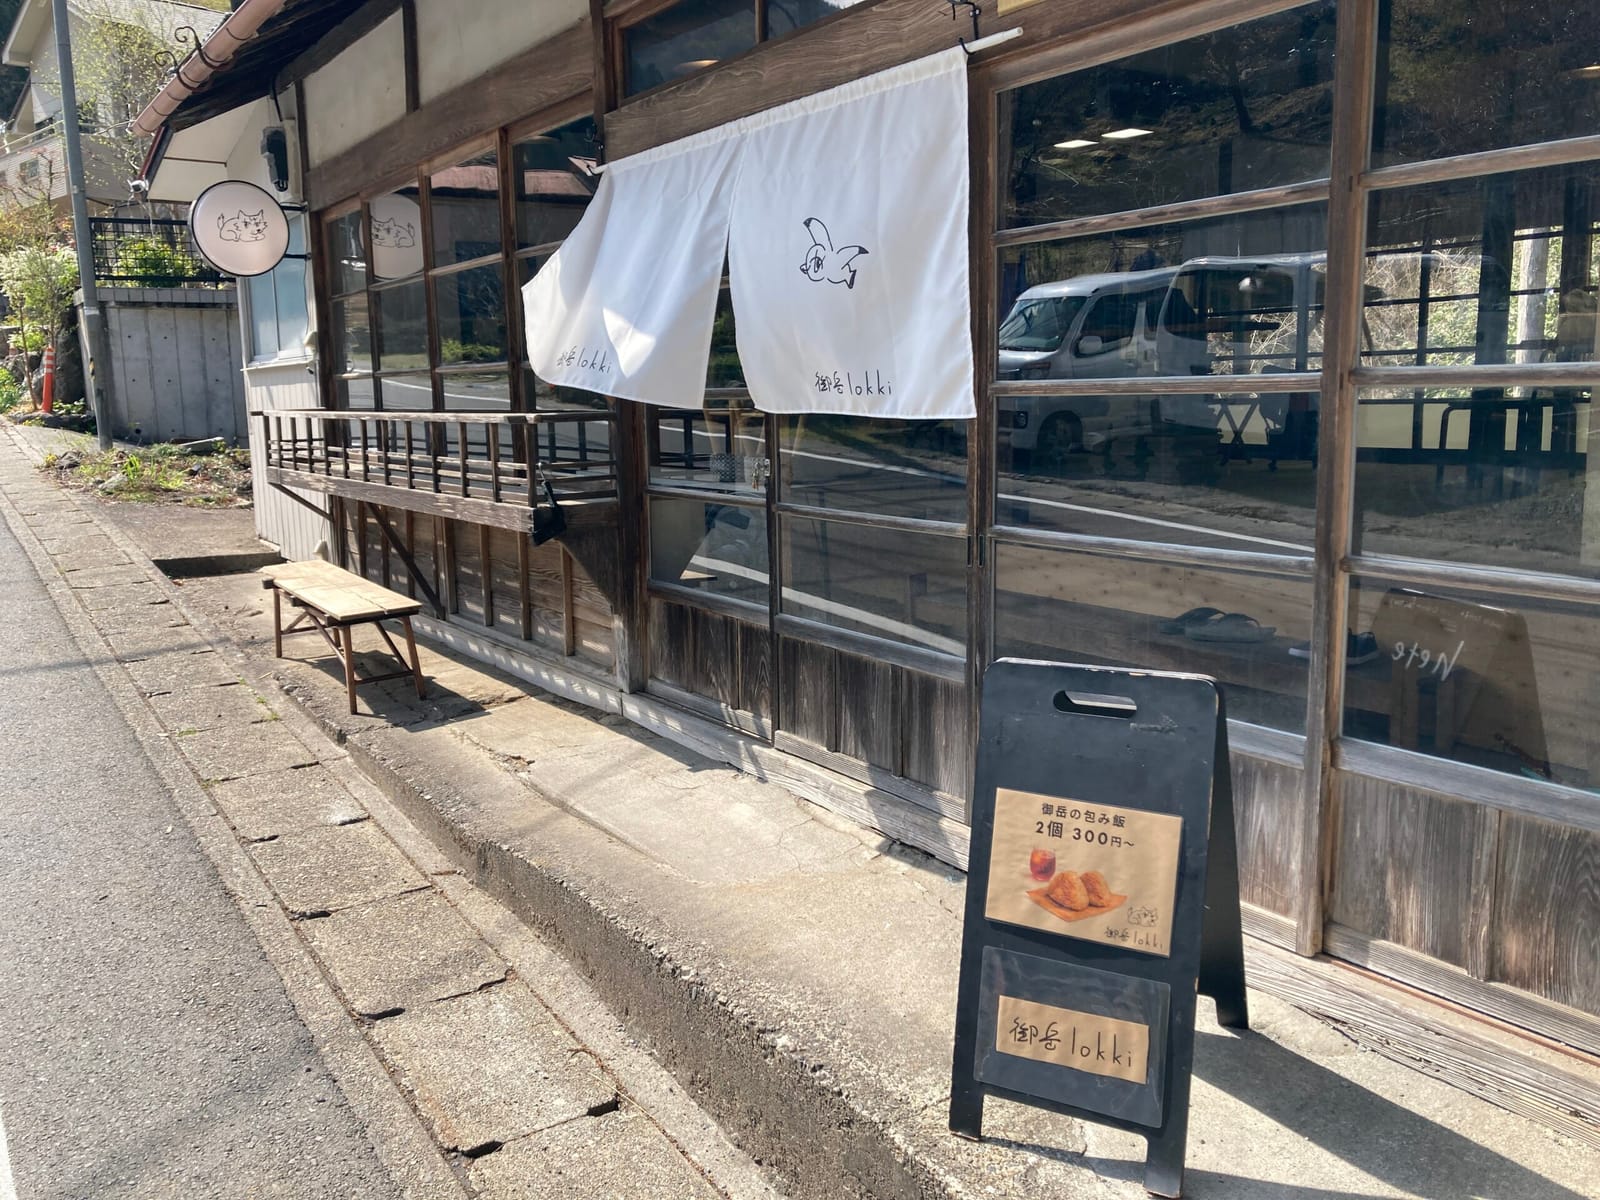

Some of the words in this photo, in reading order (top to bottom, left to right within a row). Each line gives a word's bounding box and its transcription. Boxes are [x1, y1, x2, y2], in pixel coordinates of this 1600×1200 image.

[847, 369, 892, 396] lokki
[1041, 802, 1127, 829] 御岳の包み飯
[1035, 820, 1064, 839] 2個
[1071, 1026, 1133, 1068] lokki
